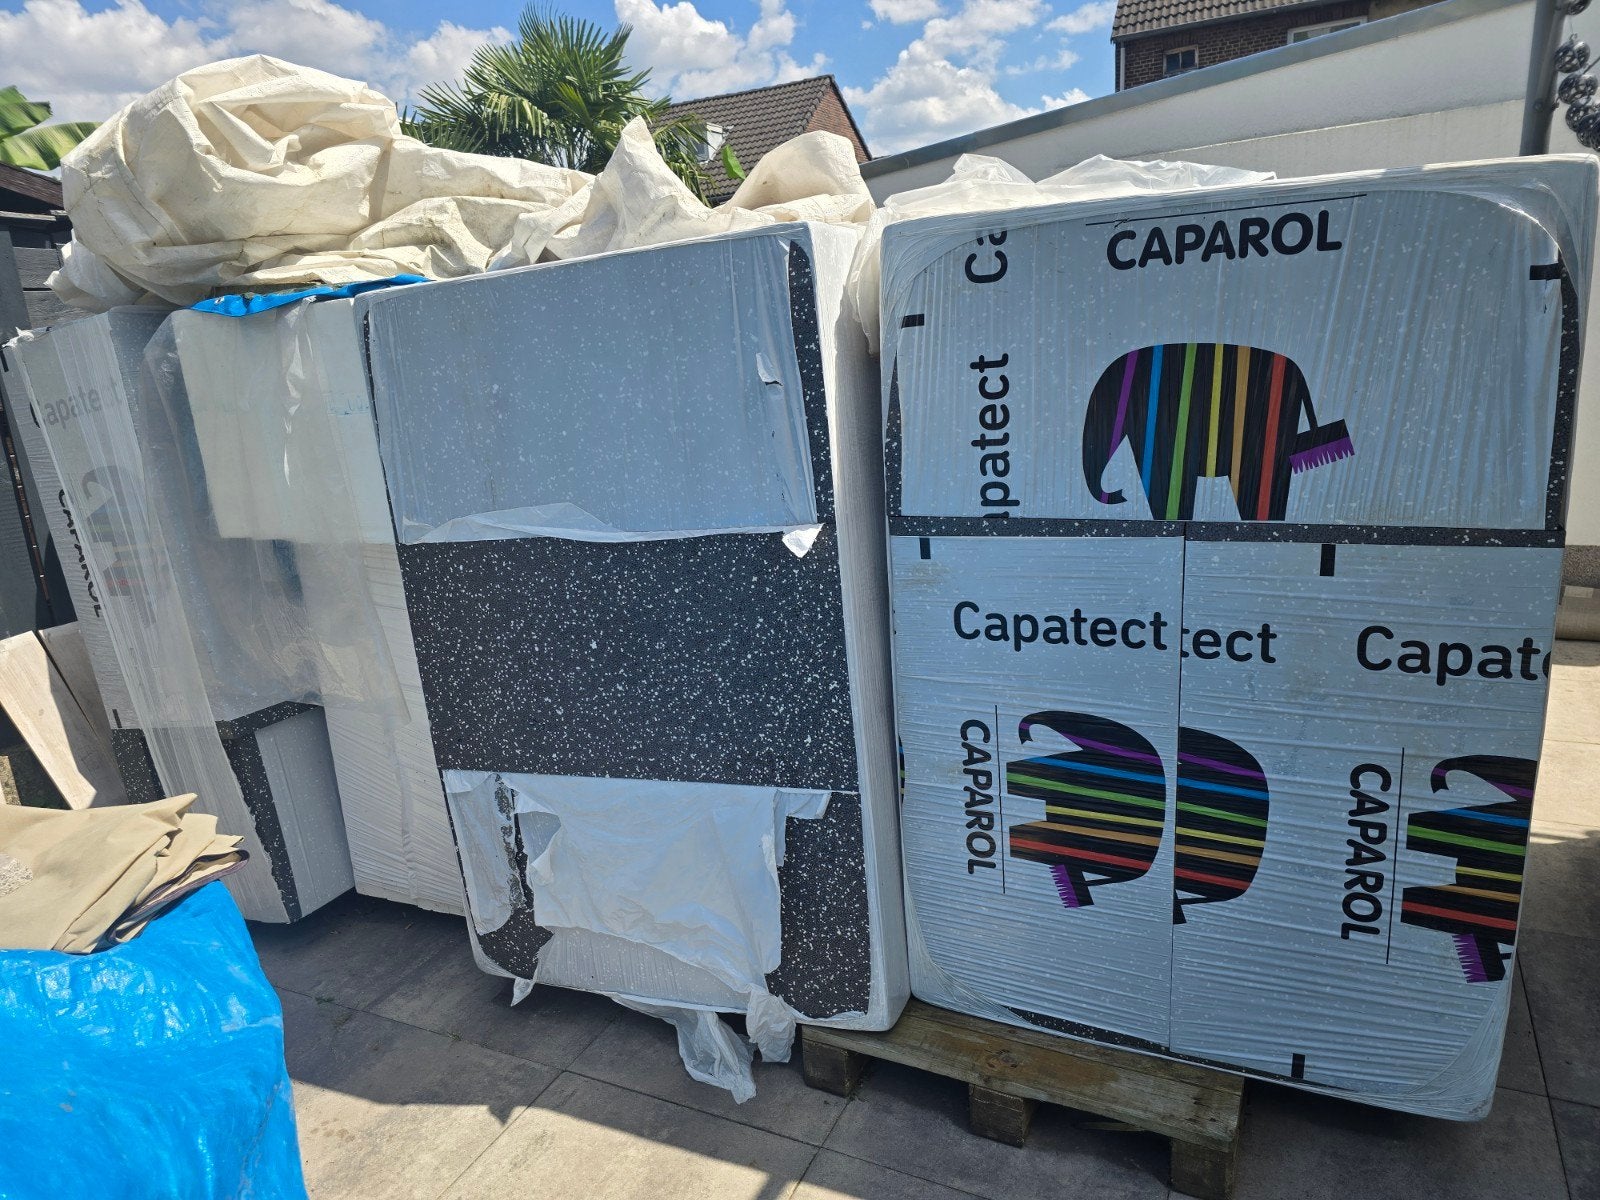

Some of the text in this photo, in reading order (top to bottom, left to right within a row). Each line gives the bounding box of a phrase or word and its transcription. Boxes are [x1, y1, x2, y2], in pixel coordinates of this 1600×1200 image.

[1106, 209, 1343, 271] CAPAROL
[969, 352, 1021, 518] patect
[953, 601, 1168, 652] Capatect
[1356, 625, 1552, 686] Capat
[960, 719, 997, 875] CAPAROL
[1341, 763, 1392, 941] CAPAROL
